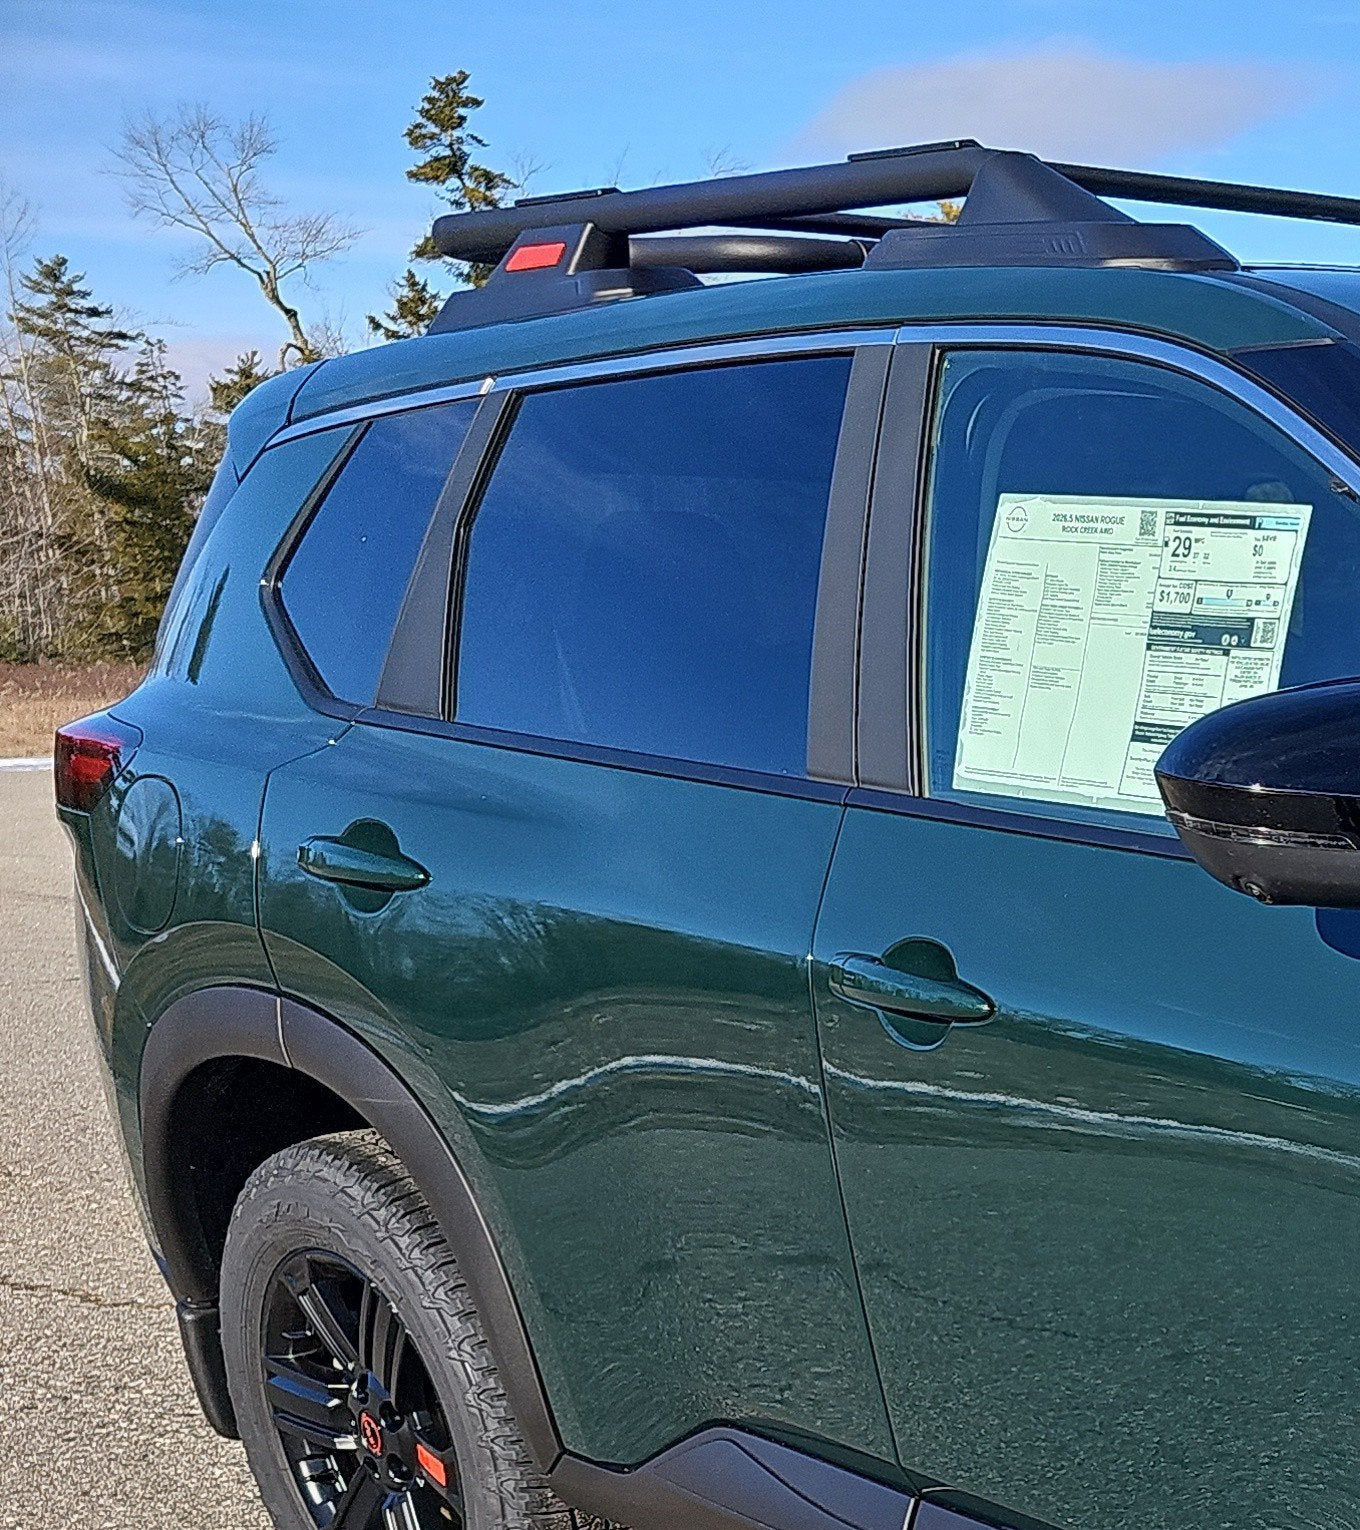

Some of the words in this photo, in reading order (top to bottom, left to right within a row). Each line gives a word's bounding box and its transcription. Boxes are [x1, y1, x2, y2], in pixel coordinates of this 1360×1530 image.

[1075, 514, 1099, 524] NISSAN
[1100, 515, 1125, 526] ROGUE
[1062, 525, 1079, 533] ROCK
[1080, 526, 1098, 534] CREEK
[1171, 535, 1192, 558] 29
[1252, 544, 1263, 557] $0
[1159, 590, 1191, 605] $1,700
